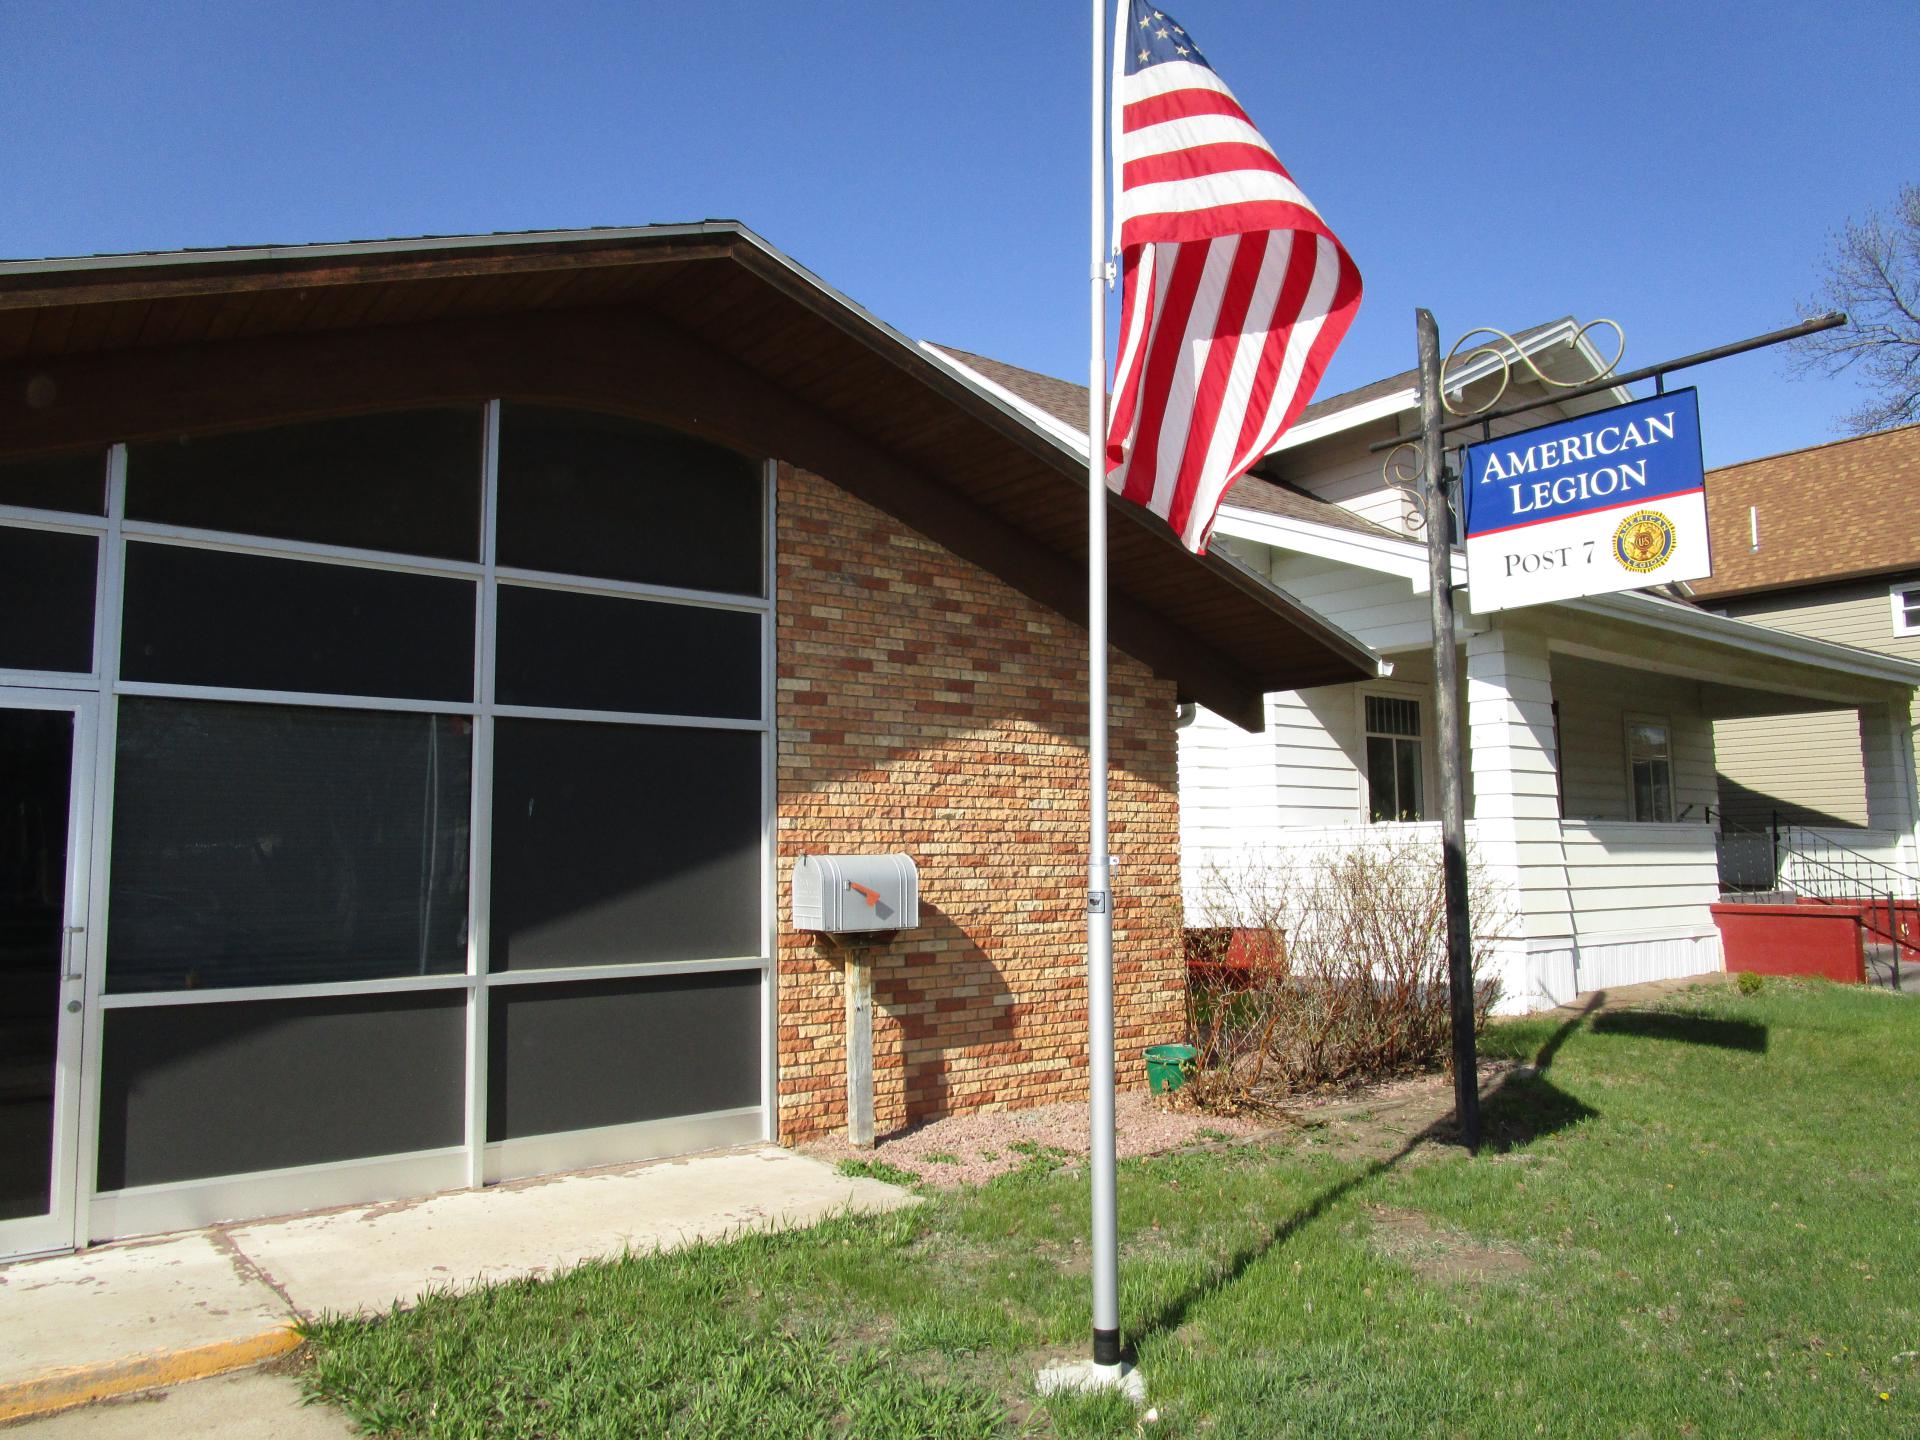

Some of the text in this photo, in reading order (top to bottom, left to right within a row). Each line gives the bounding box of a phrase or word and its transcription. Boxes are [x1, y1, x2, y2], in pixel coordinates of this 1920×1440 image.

[1481, 411, 1675, 483] AMERICAN
[1509, 460, 1647, 514] LEGION
[1619, 514, 1669, 539] AMERICAN
[1504, 541, 1596, 577] POST 7
[1628, 554, 1665, 568] LEGION
